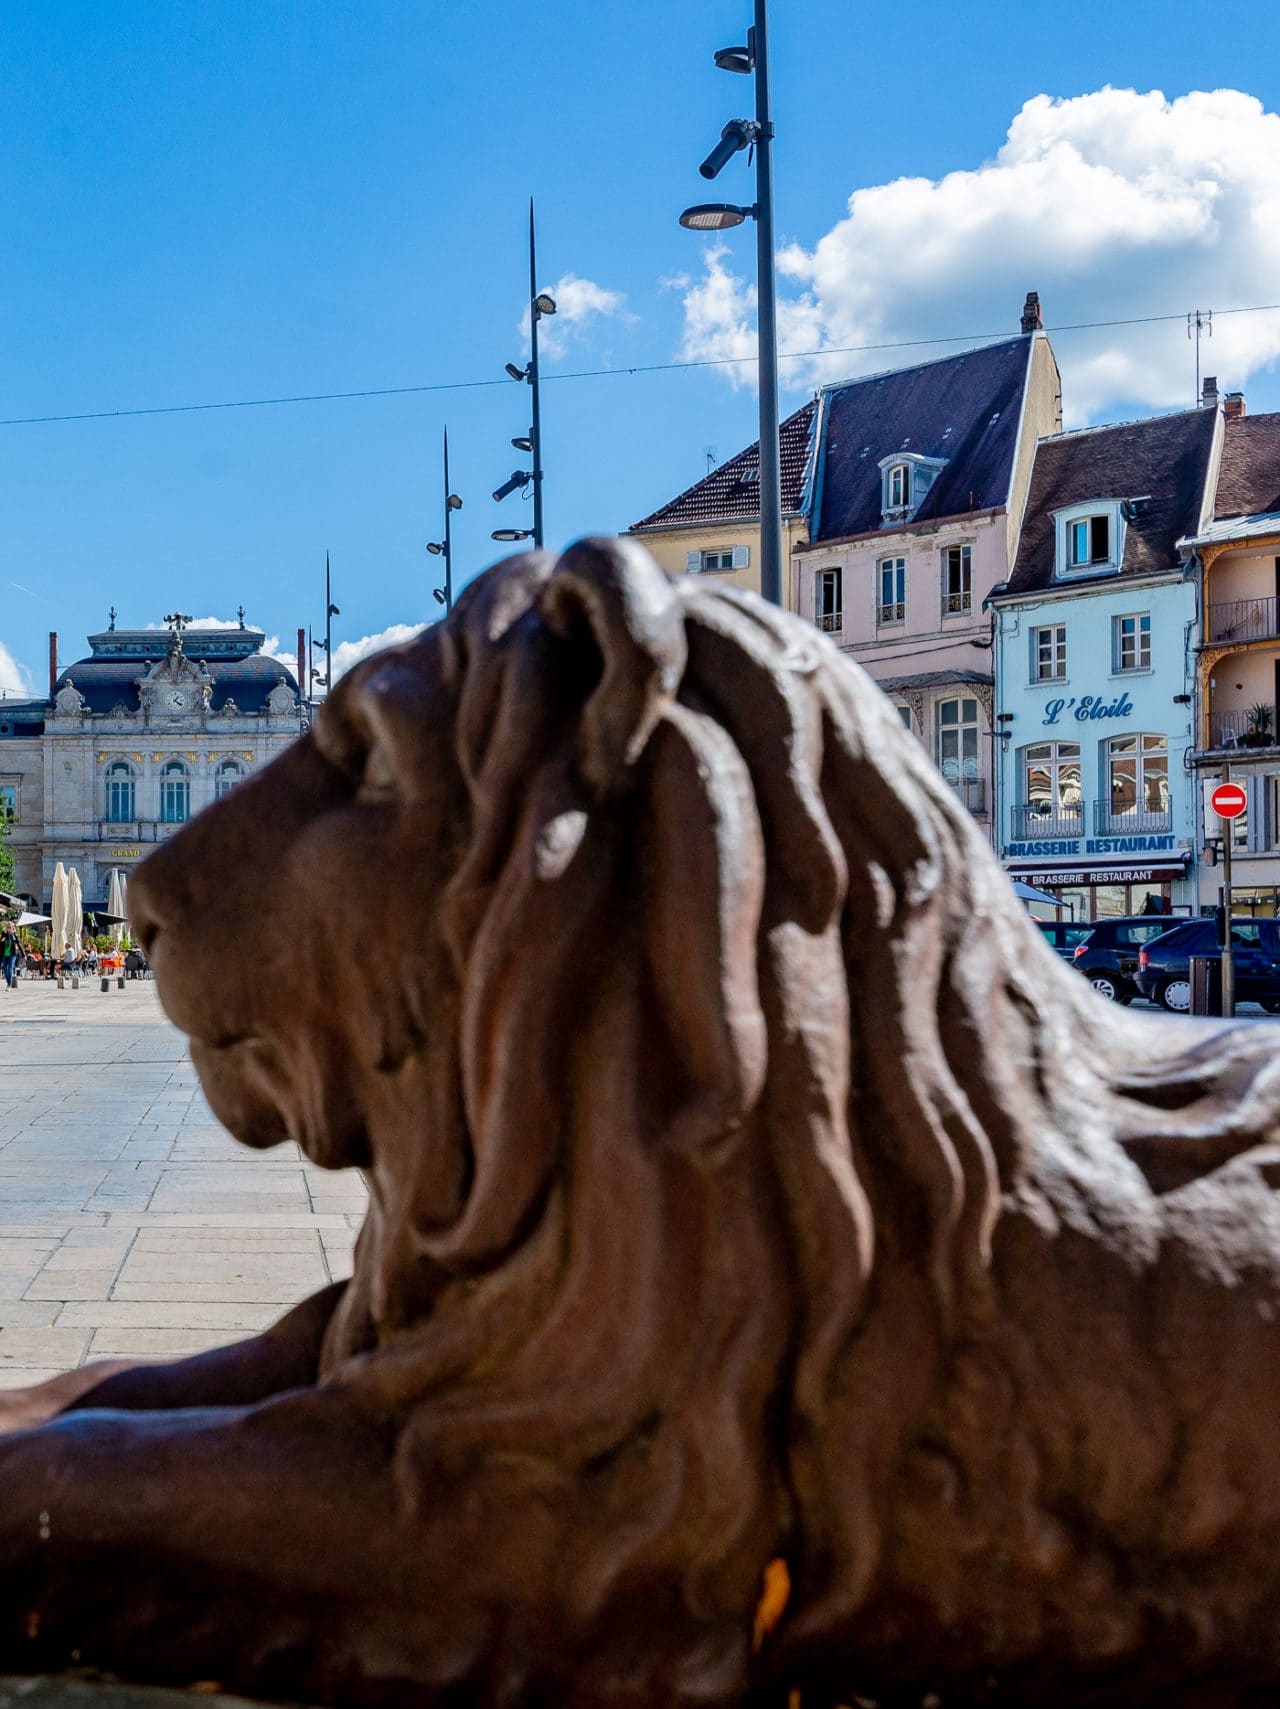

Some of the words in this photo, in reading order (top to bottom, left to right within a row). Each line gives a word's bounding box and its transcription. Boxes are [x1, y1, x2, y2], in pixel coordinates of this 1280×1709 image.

[1042, 692, 1133, 725] L'Etoile
[111, 848, 141, 857] GRAND
[1009, 841, 1080, 856] BRASSERIE
[1086, 835, 1175, 853] RESTAURANT
[1032, 873, 1084, 885] BRASSERIE
[1089, 871, 1153, 882] RESTAURANT
